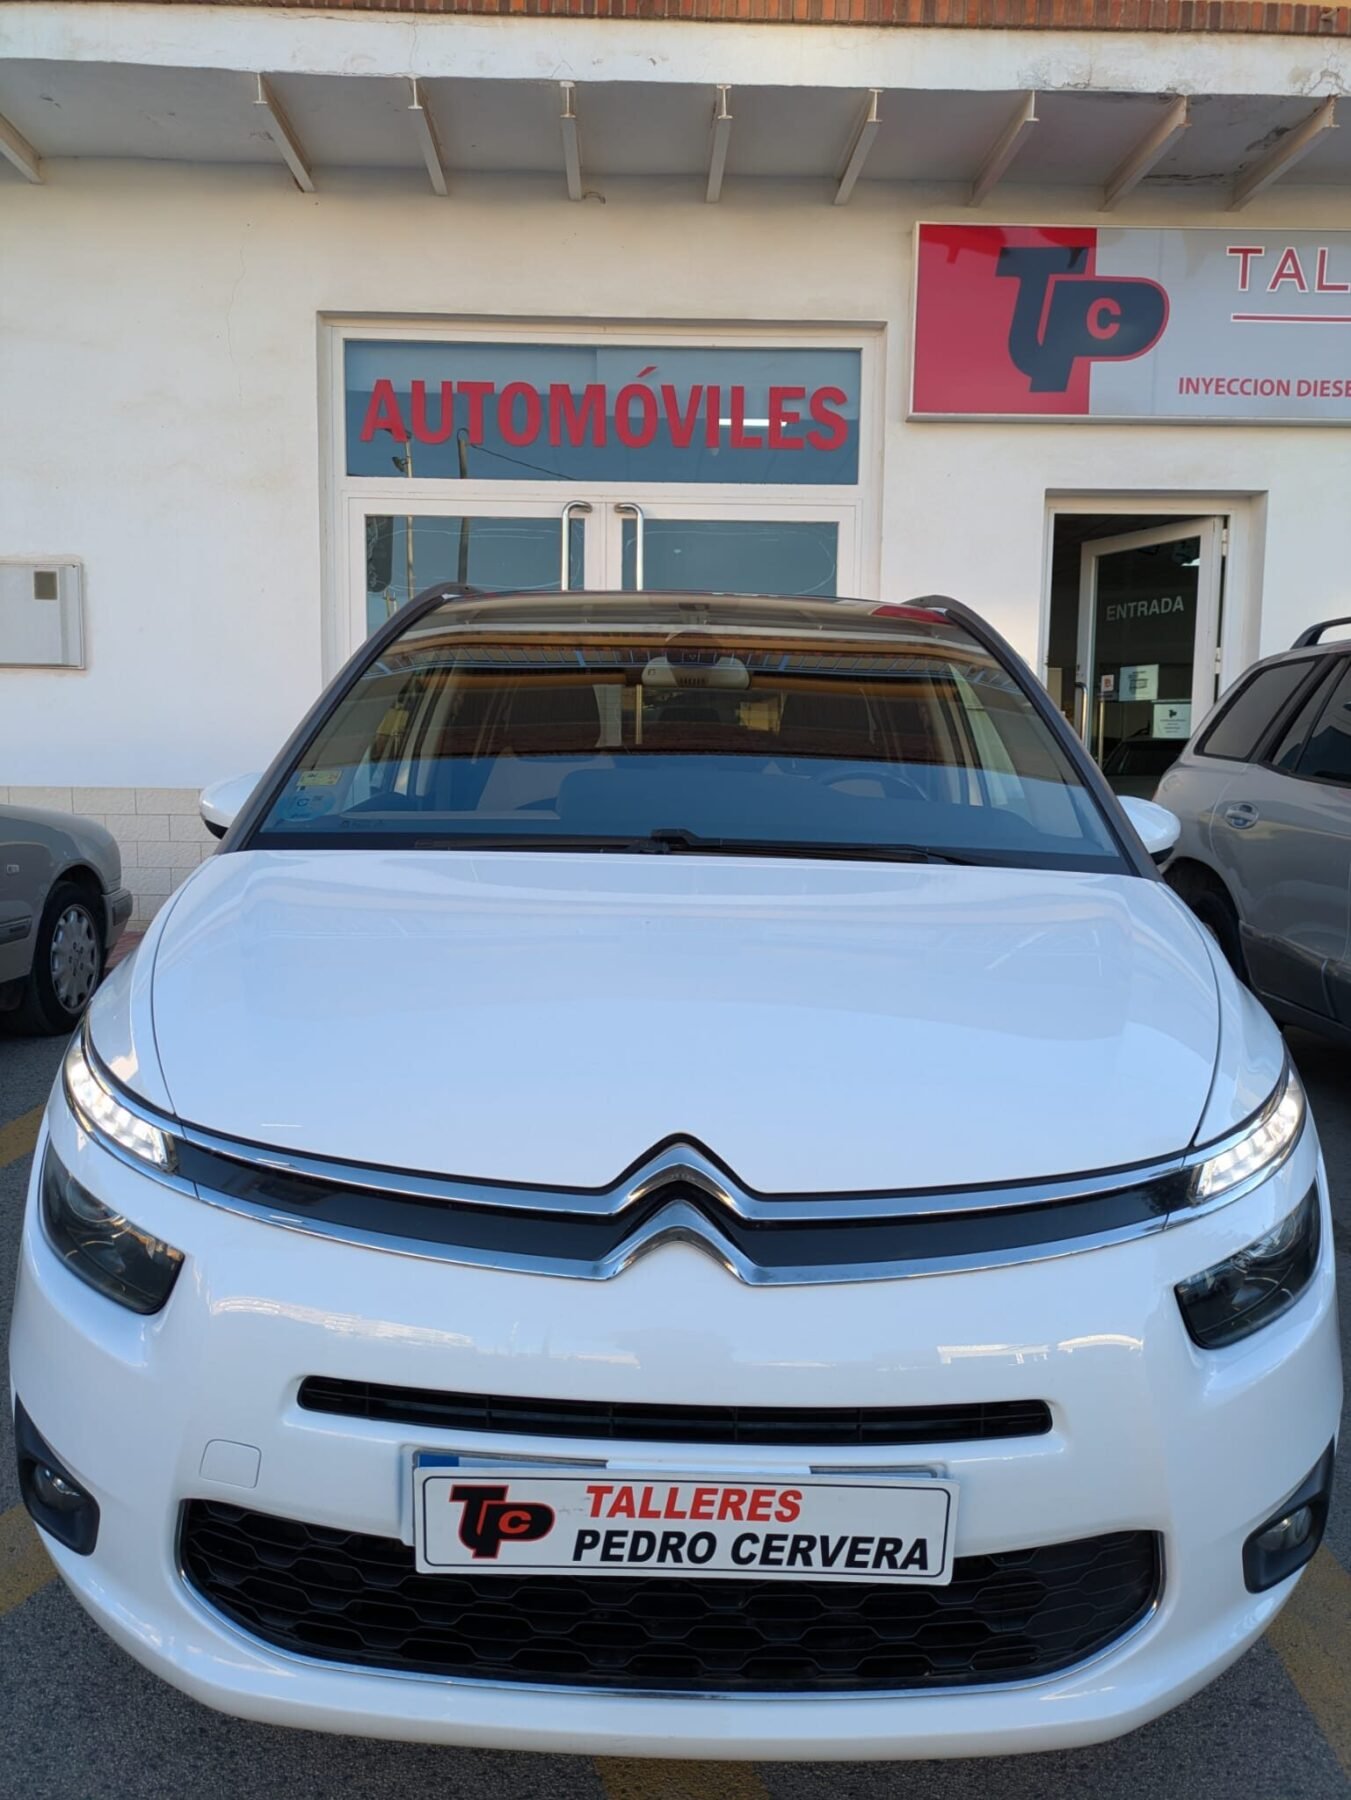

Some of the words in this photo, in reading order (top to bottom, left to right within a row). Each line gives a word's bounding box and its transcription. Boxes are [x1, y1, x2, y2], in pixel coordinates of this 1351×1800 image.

[1226, 246, 1350, 293] TAL
[1178, 377, 1291, 397] INYECCION
[360, 366, 849, 451] AUTOMÓVILES
[1106, 595, 1184, 621] ENTRADA
[585, 1485, 803, 1523] TALLERES
[572, 1529, 717, 1565] PEDRO
[730, 1532, 929, 1571] CERVERA
